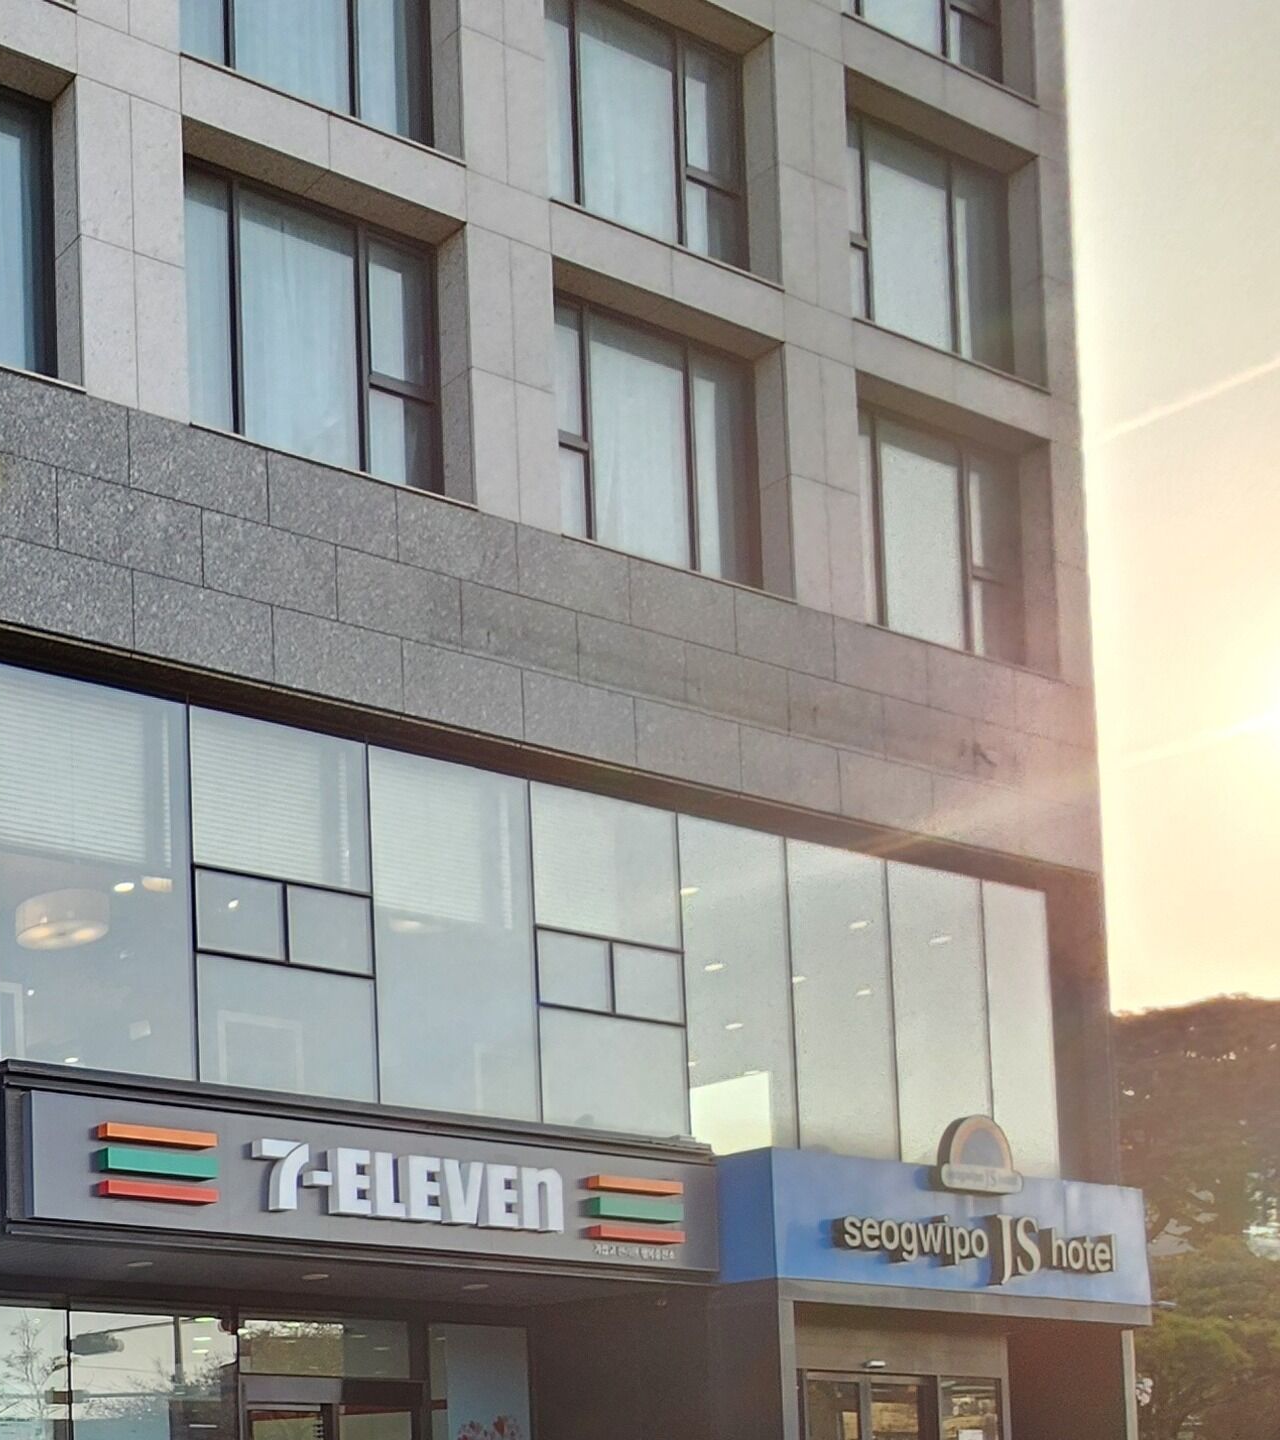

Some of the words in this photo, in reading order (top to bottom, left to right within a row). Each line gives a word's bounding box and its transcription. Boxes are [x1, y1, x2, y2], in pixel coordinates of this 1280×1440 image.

[842, 1214, 989, 1263] seogwipo
[995, 1213, 1042, 1286] JS
[1051, 1227, 1117, 1273] hotel
